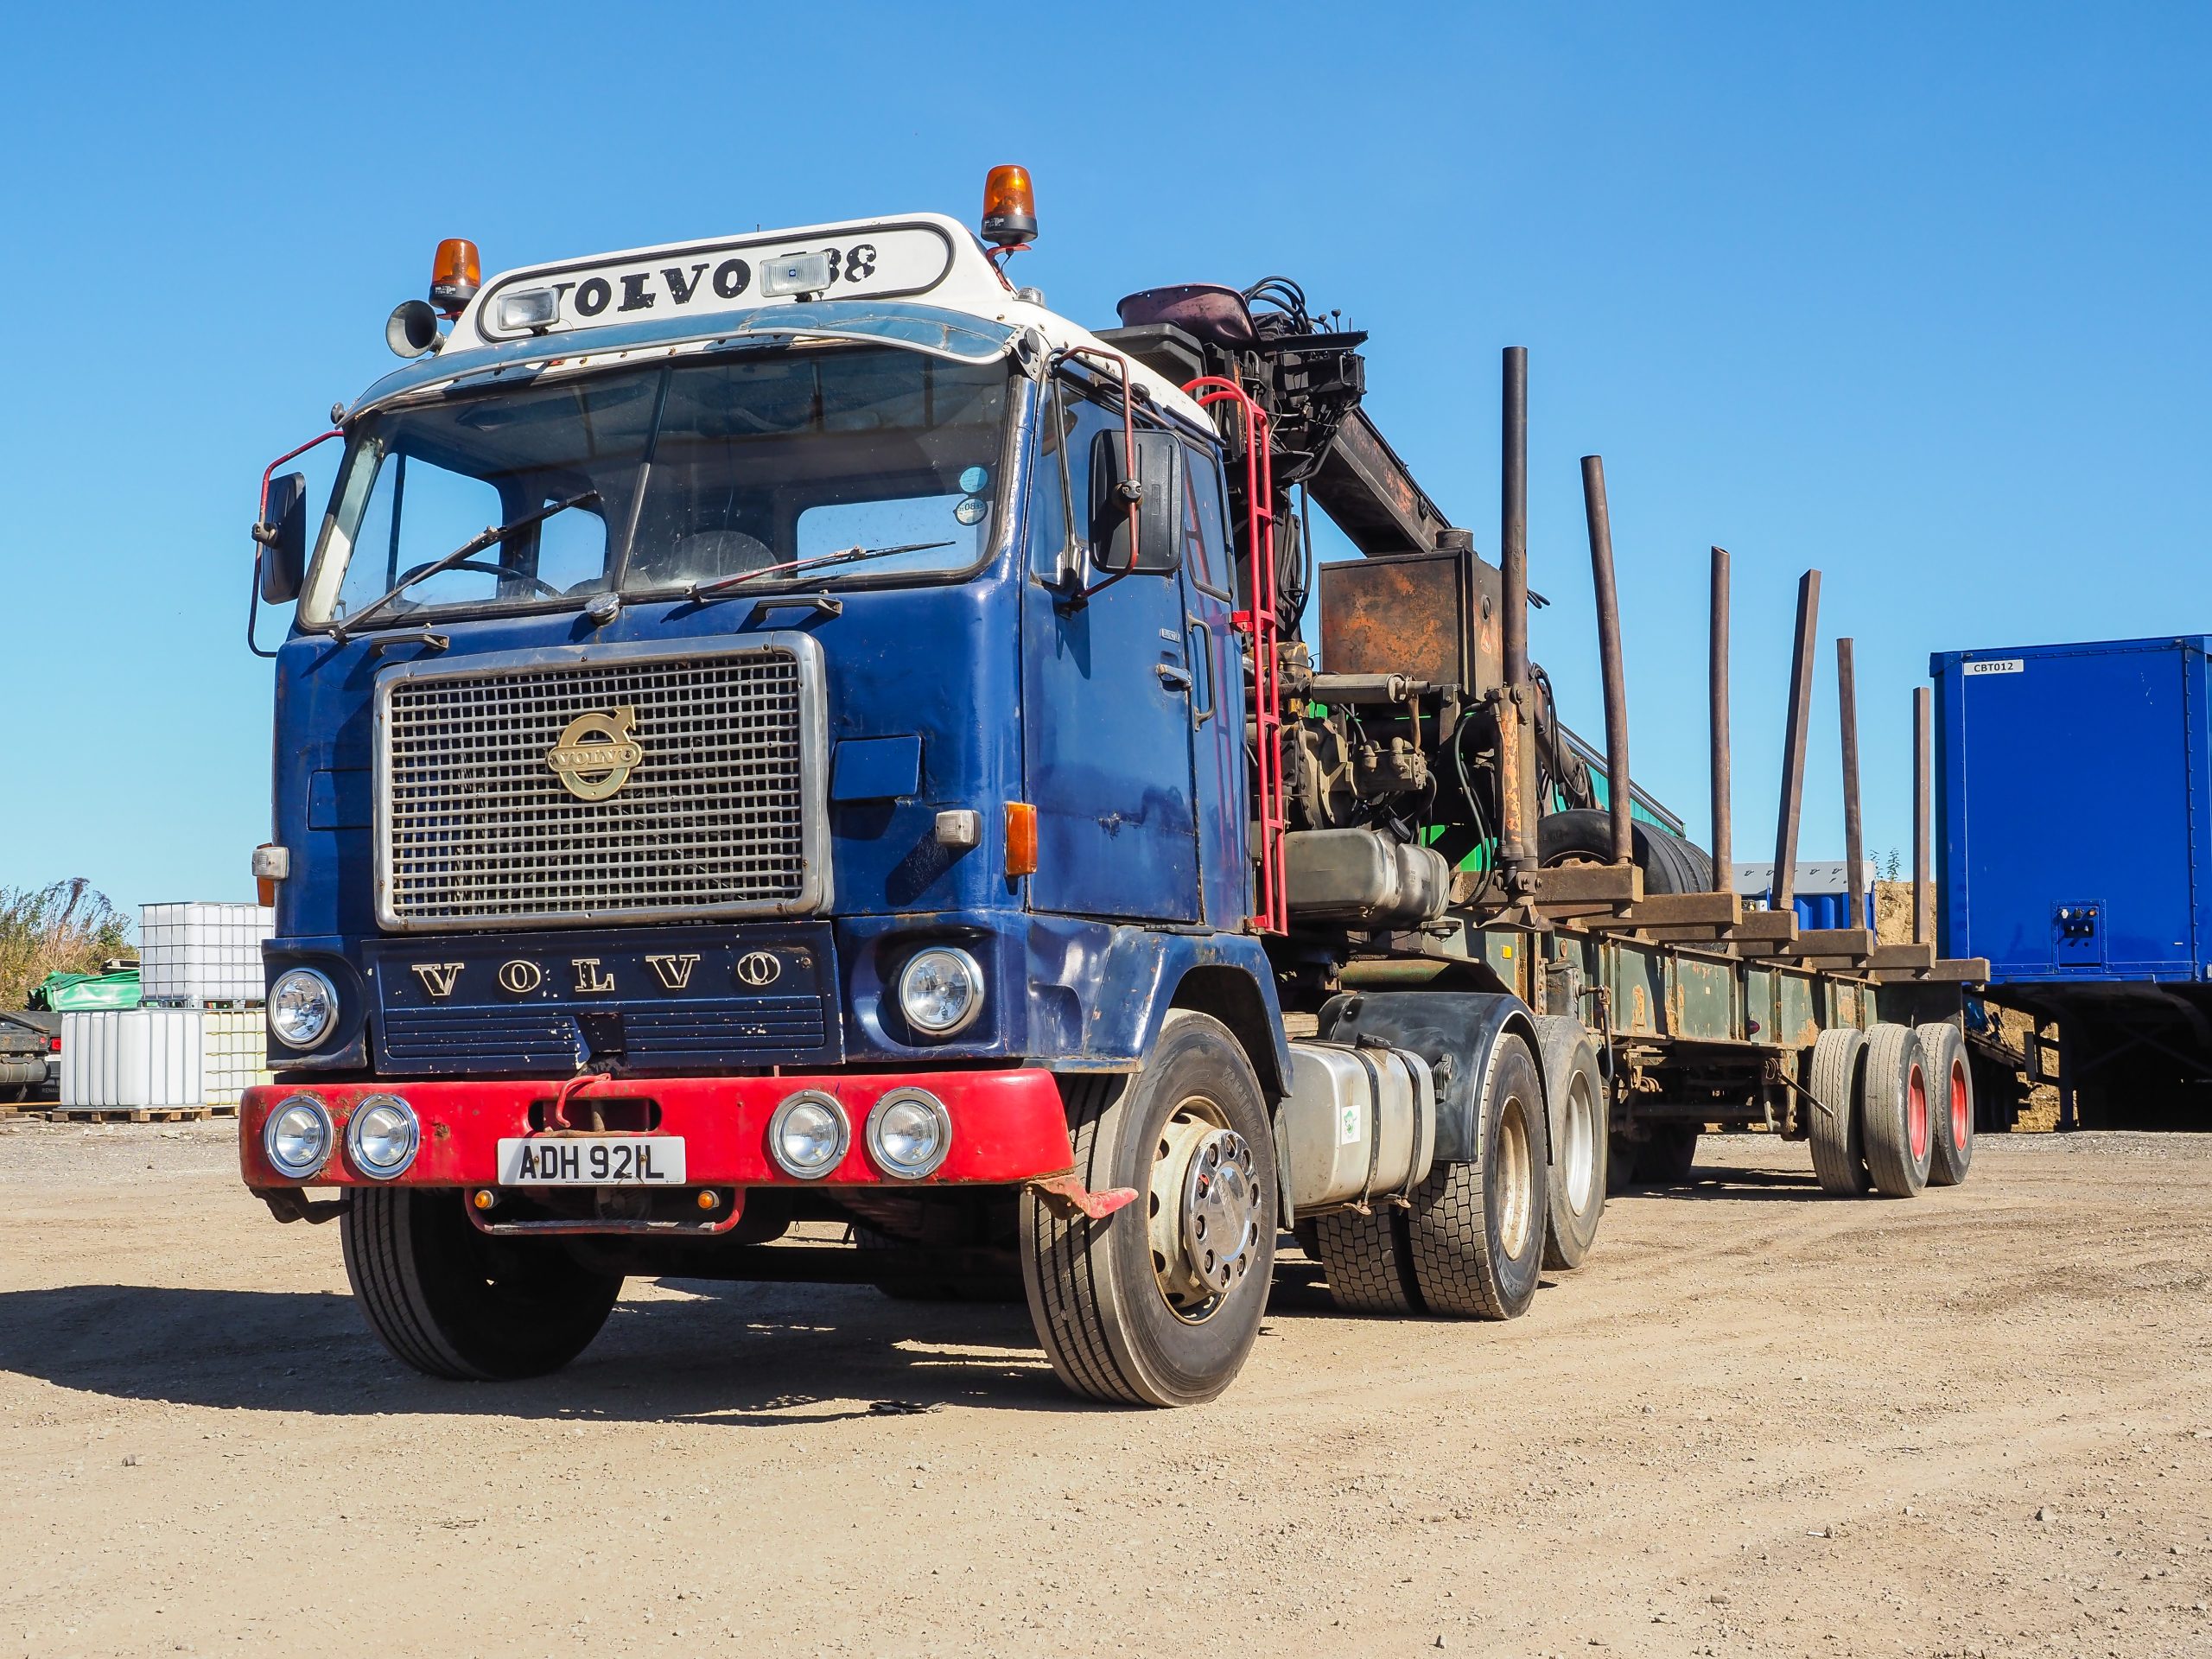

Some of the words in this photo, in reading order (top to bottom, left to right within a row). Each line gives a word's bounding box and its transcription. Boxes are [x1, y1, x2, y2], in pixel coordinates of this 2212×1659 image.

[1974, 662, 2014, 672] CBT012
[555, 747, 637, 766] VOLVO
[411, 951, 781, 996] VOLVO
[518, 1145, 580, 1179] ADH
[589, 1144, 664, 1179] 921L
